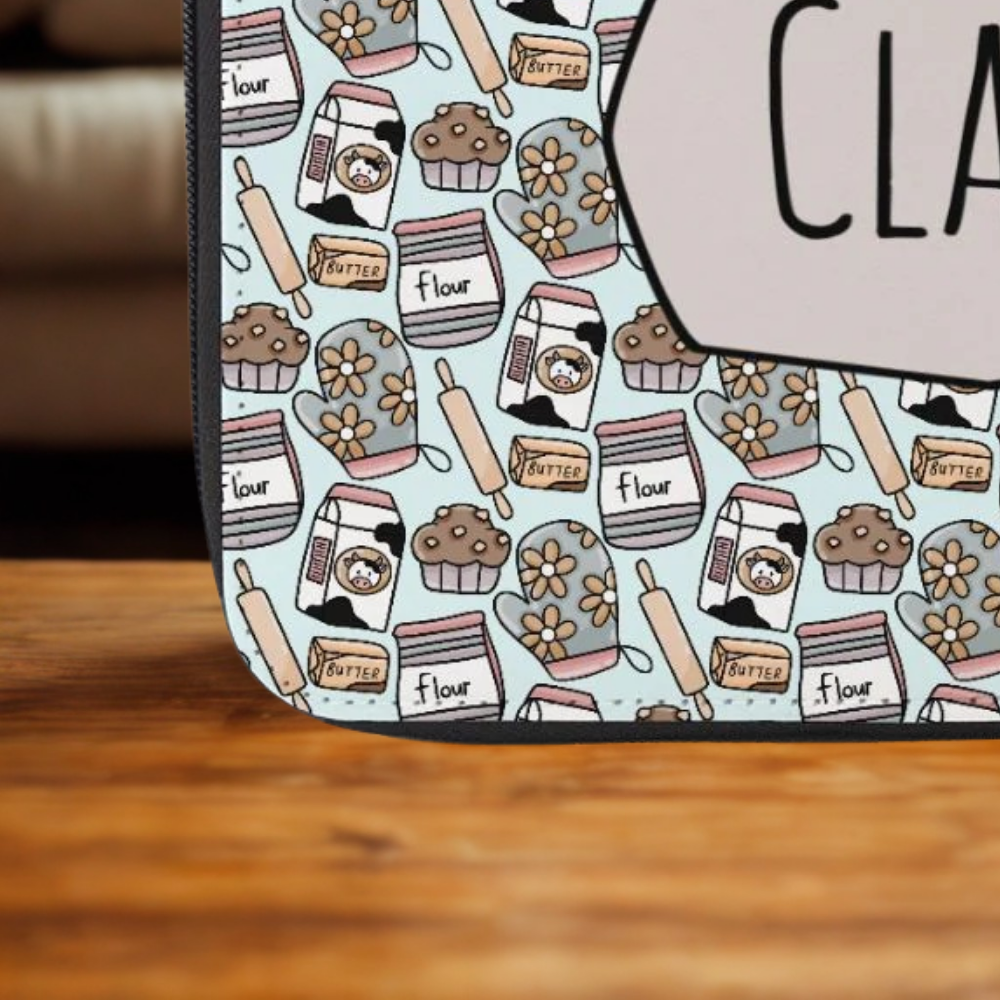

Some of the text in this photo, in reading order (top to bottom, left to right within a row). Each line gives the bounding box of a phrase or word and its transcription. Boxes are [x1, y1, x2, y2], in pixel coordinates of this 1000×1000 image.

[527, 58, 582, 78] BUTTER
[326, 259, 381, 279] BUTTER
[414, 270, 471, 302] flour
[527, 460, 582, 480] BUTTER
[929, 460, 984, 480] BUTTER
[615, 471, 672, 503] flour
[326, 661, 381, 681] BUTTER
[728, 661, 783, 681] BUTTER
[414, 672, 471, 704] flour
[816, 672, 873, 704] flour
